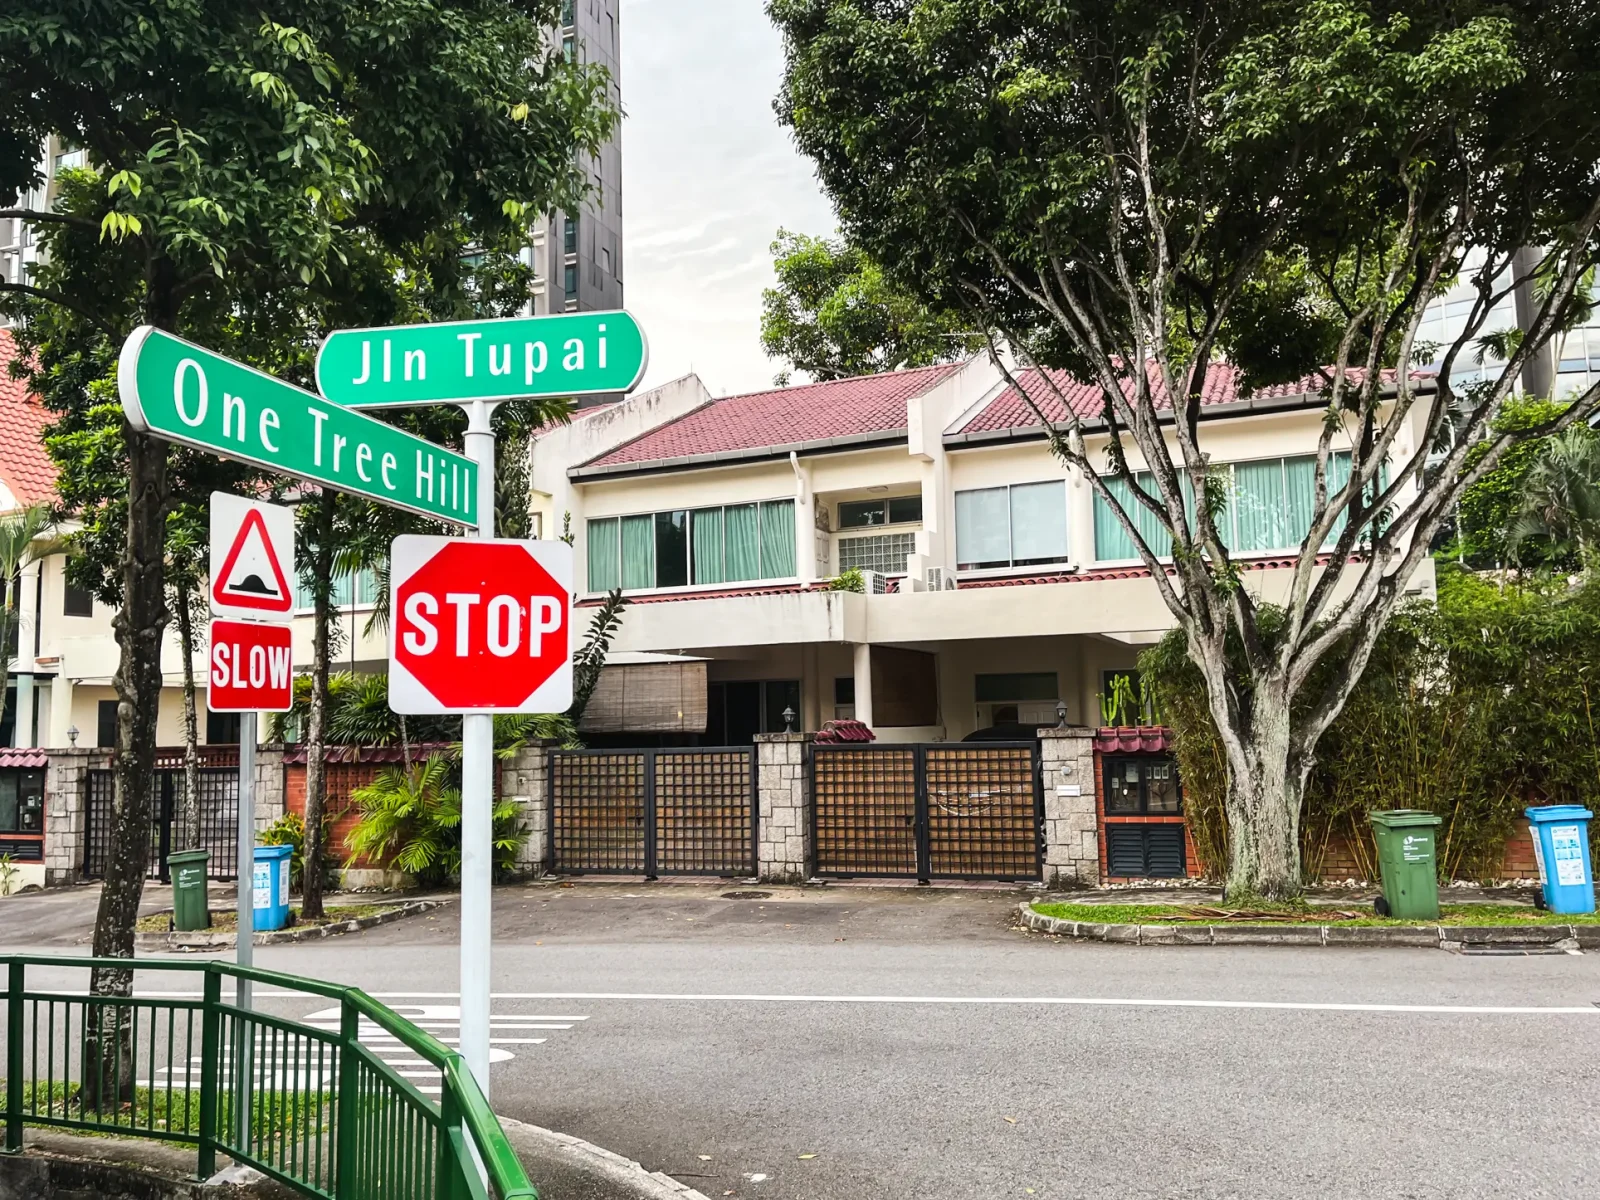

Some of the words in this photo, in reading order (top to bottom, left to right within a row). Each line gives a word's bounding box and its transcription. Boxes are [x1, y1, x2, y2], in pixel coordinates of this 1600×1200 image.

[352, 339, 427, 386] Jln
[457, 323, 608, 386] Tupai
[173, 357, 281, 454] One
[307, 406, 398, 491] Tree
[415, 448, 471, 515] Hill
[402, 592, 563, 658] STOP
[212, 642, 290, 690] SLOW
